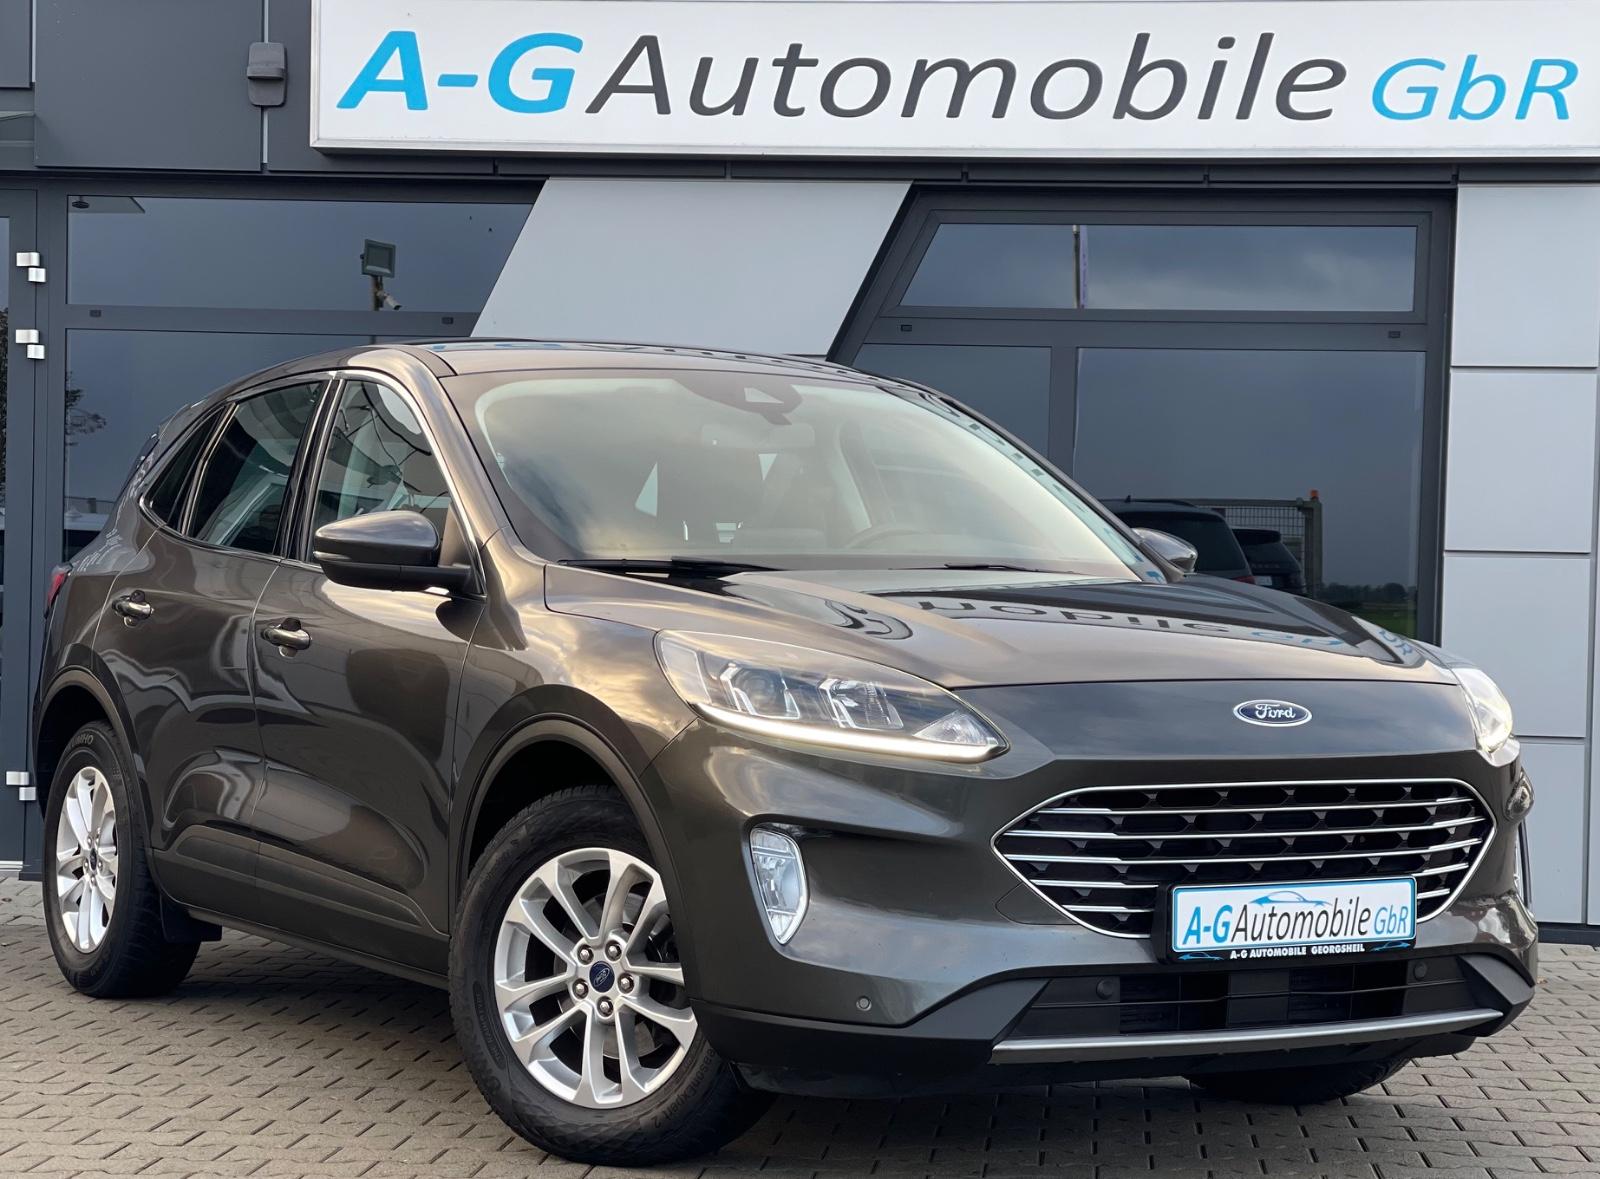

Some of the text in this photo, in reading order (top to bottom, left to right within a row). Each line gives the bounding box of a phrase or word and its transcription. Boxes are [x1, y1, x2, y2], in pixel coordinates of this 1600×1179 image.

[1372, 54, 1578, 121] GbR
[1255, 704, 1296, 719] Ford
[1373, 905, 1409, 935] GbR
[1230, 943, 1365, 960] A-G AUTOMOBILE GEORGSHEIL
